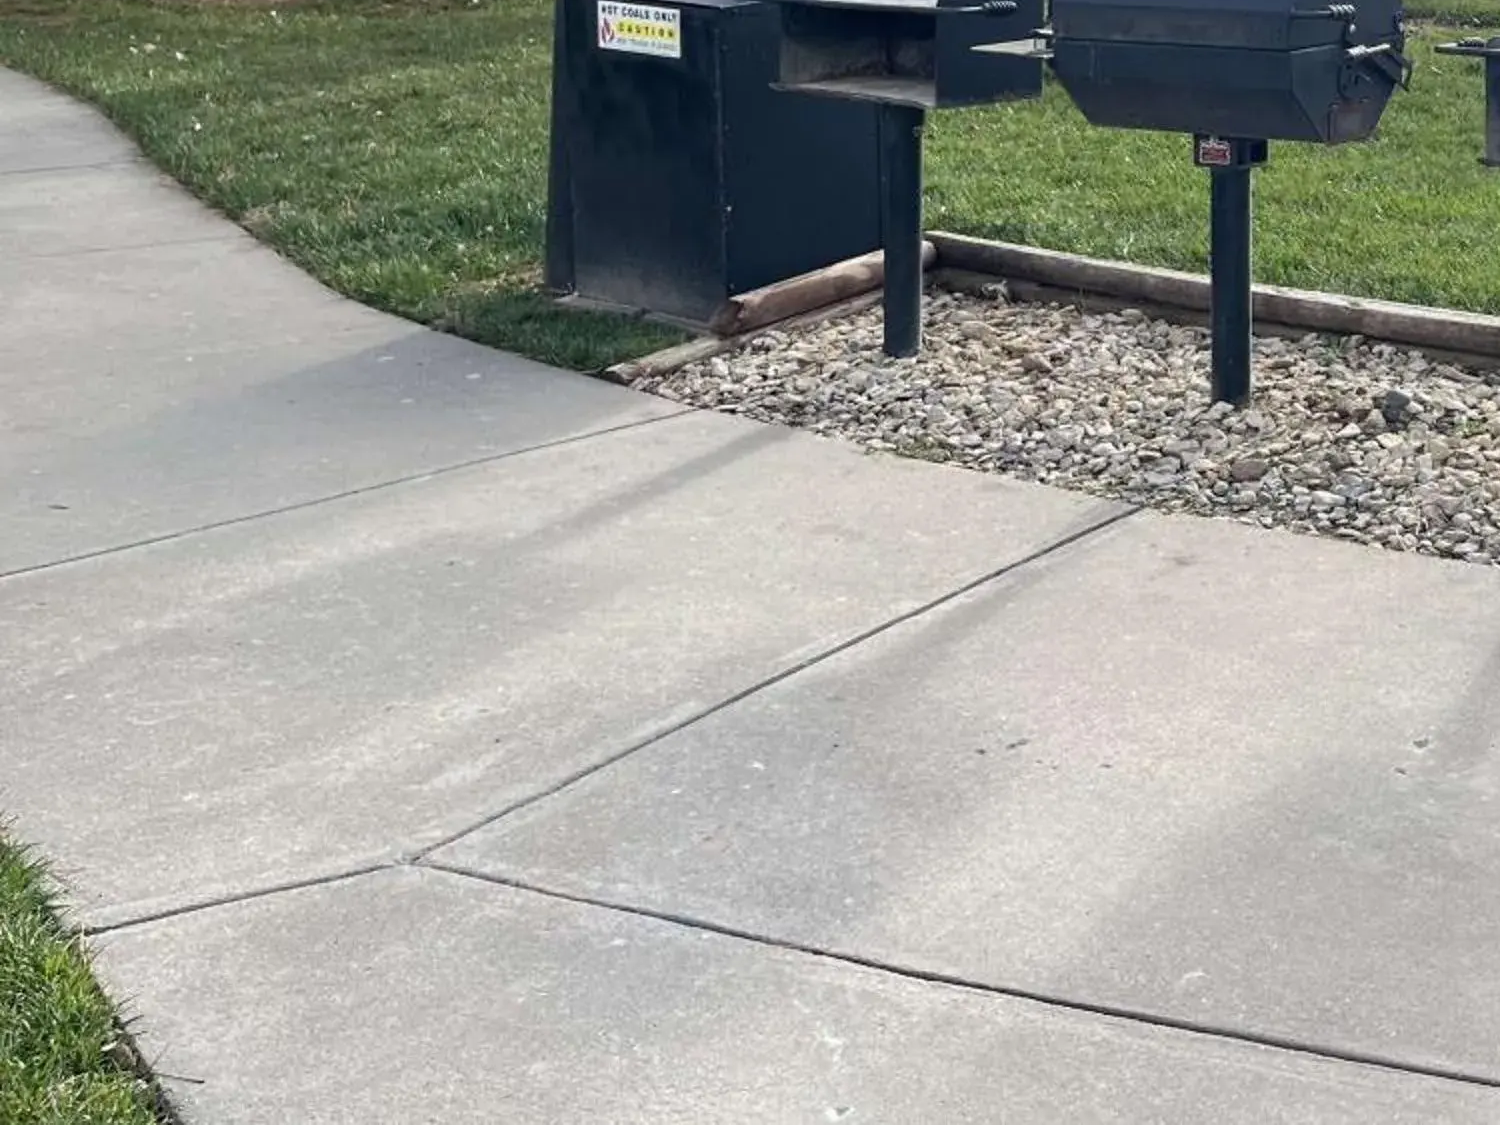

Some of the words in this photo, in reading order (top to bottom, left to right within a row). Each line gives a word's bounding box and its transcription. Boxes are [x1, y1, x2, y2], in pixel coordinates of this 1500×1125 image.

[621, 7, 650, 20] COALS
[654, 11, 677, 22] ONLY
[619, 22, 674, 37] CAUTION
